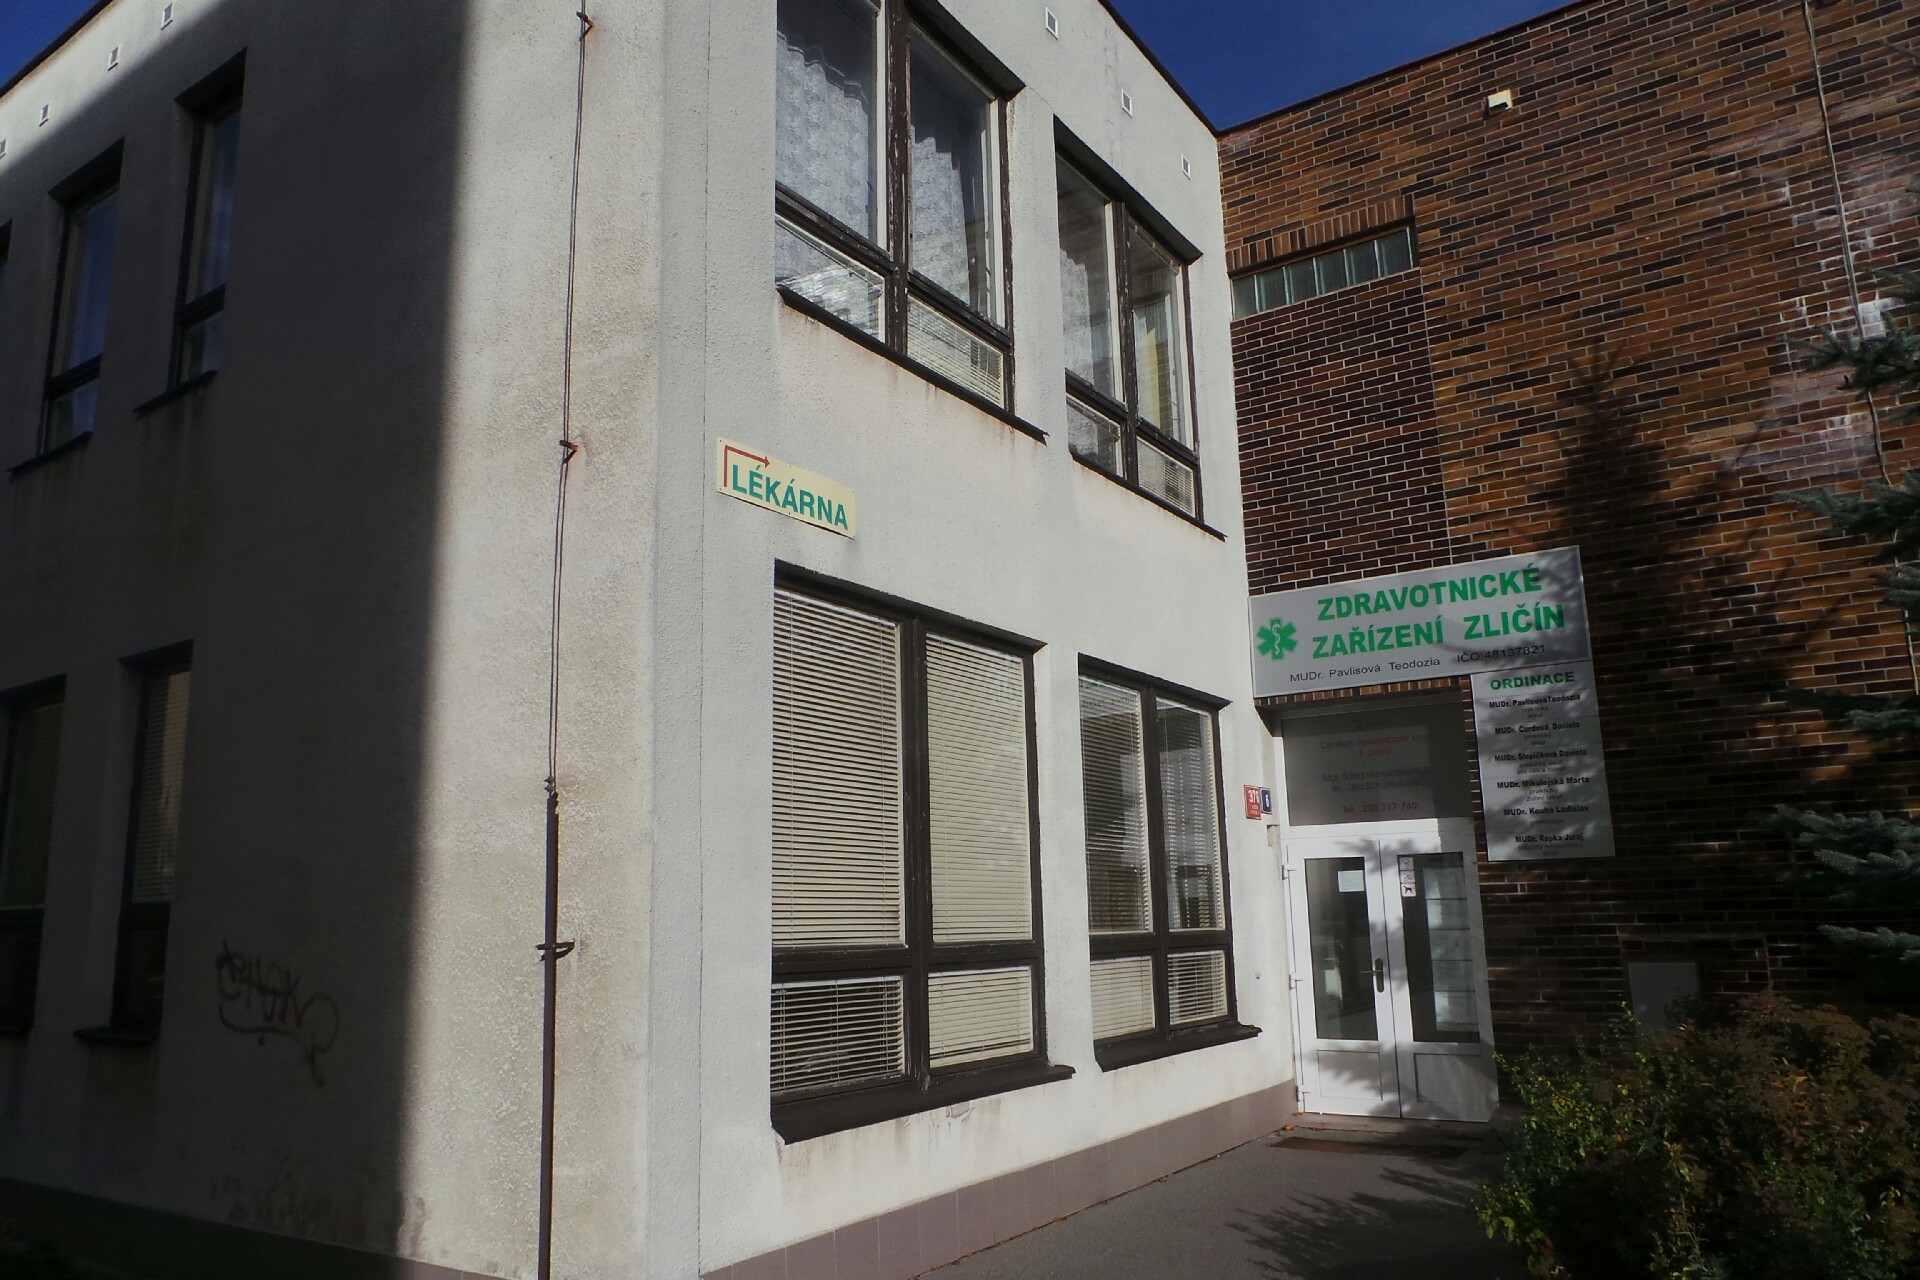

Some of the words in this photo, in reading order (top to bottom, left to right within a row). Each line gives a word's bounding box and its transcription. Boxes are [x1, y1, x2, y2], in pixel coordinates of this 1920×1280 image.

[732, 464, 848, 530] LÉKÁRNA
[1317, 562, 1543, 621] ZDRAVOTNICKÉ
[1312, 616, 1444, 660] ZAŘÍZENÍ
[1463, 602, 1565, 641] ZLIČÍN
[1290, 670, 1324, 682] MUDr.
[1329, 663, 1381, 678] Pavlisová
[1388, 656, 1440, 671] Teodozia
[1490, 671, 1575, 690] ORDINACE
[1489, 699, 1511, 709] MUDr.
[1495, 727, 1517, 735] MUDr.
[1552, 721, 1580, 730] Daniela
[1494, 753, 1517, 762] MUDr.
[1559, 749, 1587, 758] Daniela
[1497, 781, 1521, 789] MUDr.
[1566, 775, 1590, 784] Marta
[1503, 808, 1527, 816] MUDr.
[1529, 805, 1554, 815] Kouba
[1556, 803, 1589, 813] Ladislav
[1515, 835, 1538, 843] MUDr.
